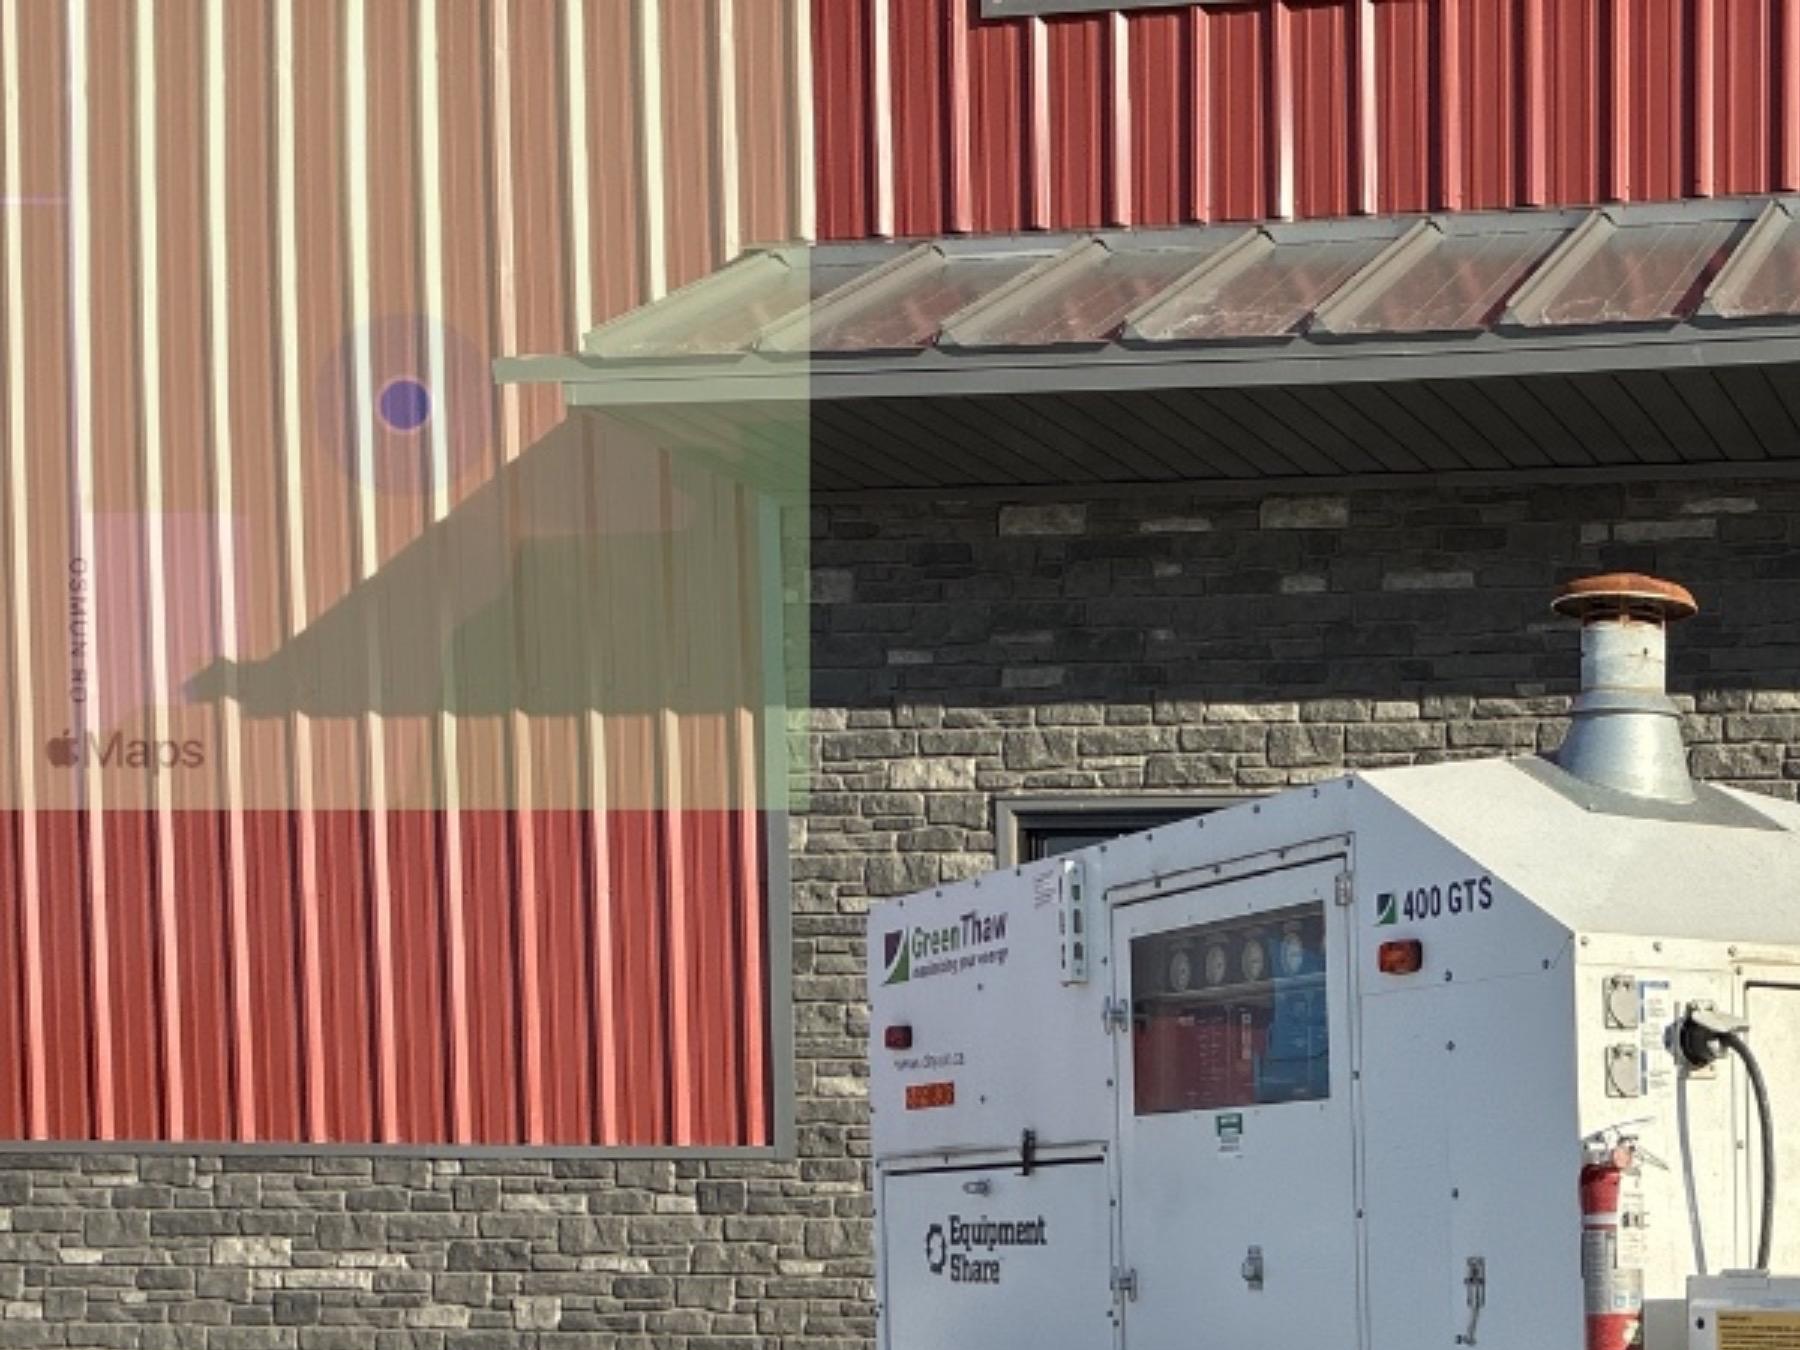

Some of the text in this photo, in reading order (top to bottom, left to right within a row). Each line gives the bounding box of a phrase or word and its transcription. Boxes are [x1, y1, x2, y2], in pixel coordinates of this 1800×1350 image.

[1402, 874, 1494, 921] 400 GTS
[910, 910, 1009, 959] GreenThaw
[948, 1213, 1048, 1252] Equipment
[950, 1252, 1000, 1285] Share
